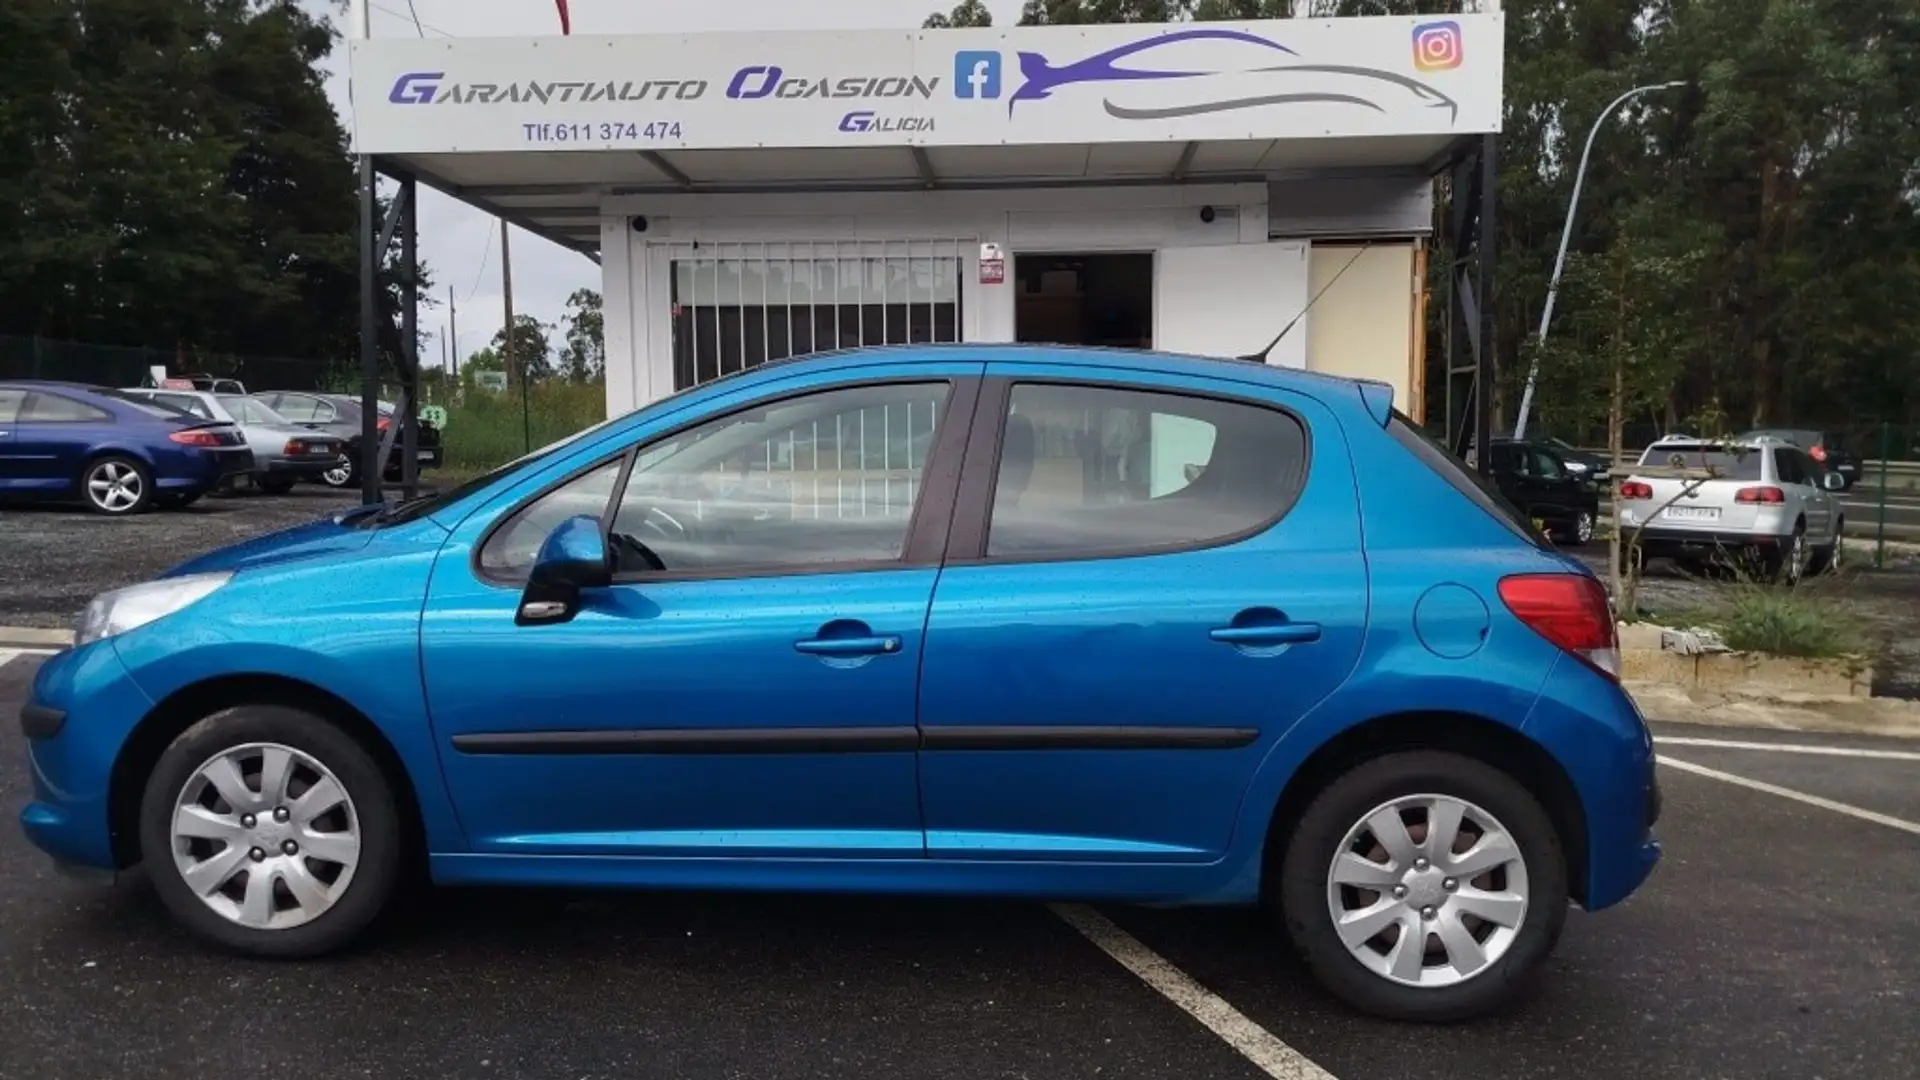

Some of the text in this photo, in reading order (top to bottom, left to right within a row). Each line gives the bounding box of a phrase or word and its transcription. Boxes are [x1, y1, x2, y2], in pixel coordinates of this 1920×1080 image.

[388, 65, 941, 105] GARANTIAUTO OCASION
[599, 122, 638, 141] 374
[643, 121, 683, 140] 474
[837, 110, 936, 133] GALICIA
